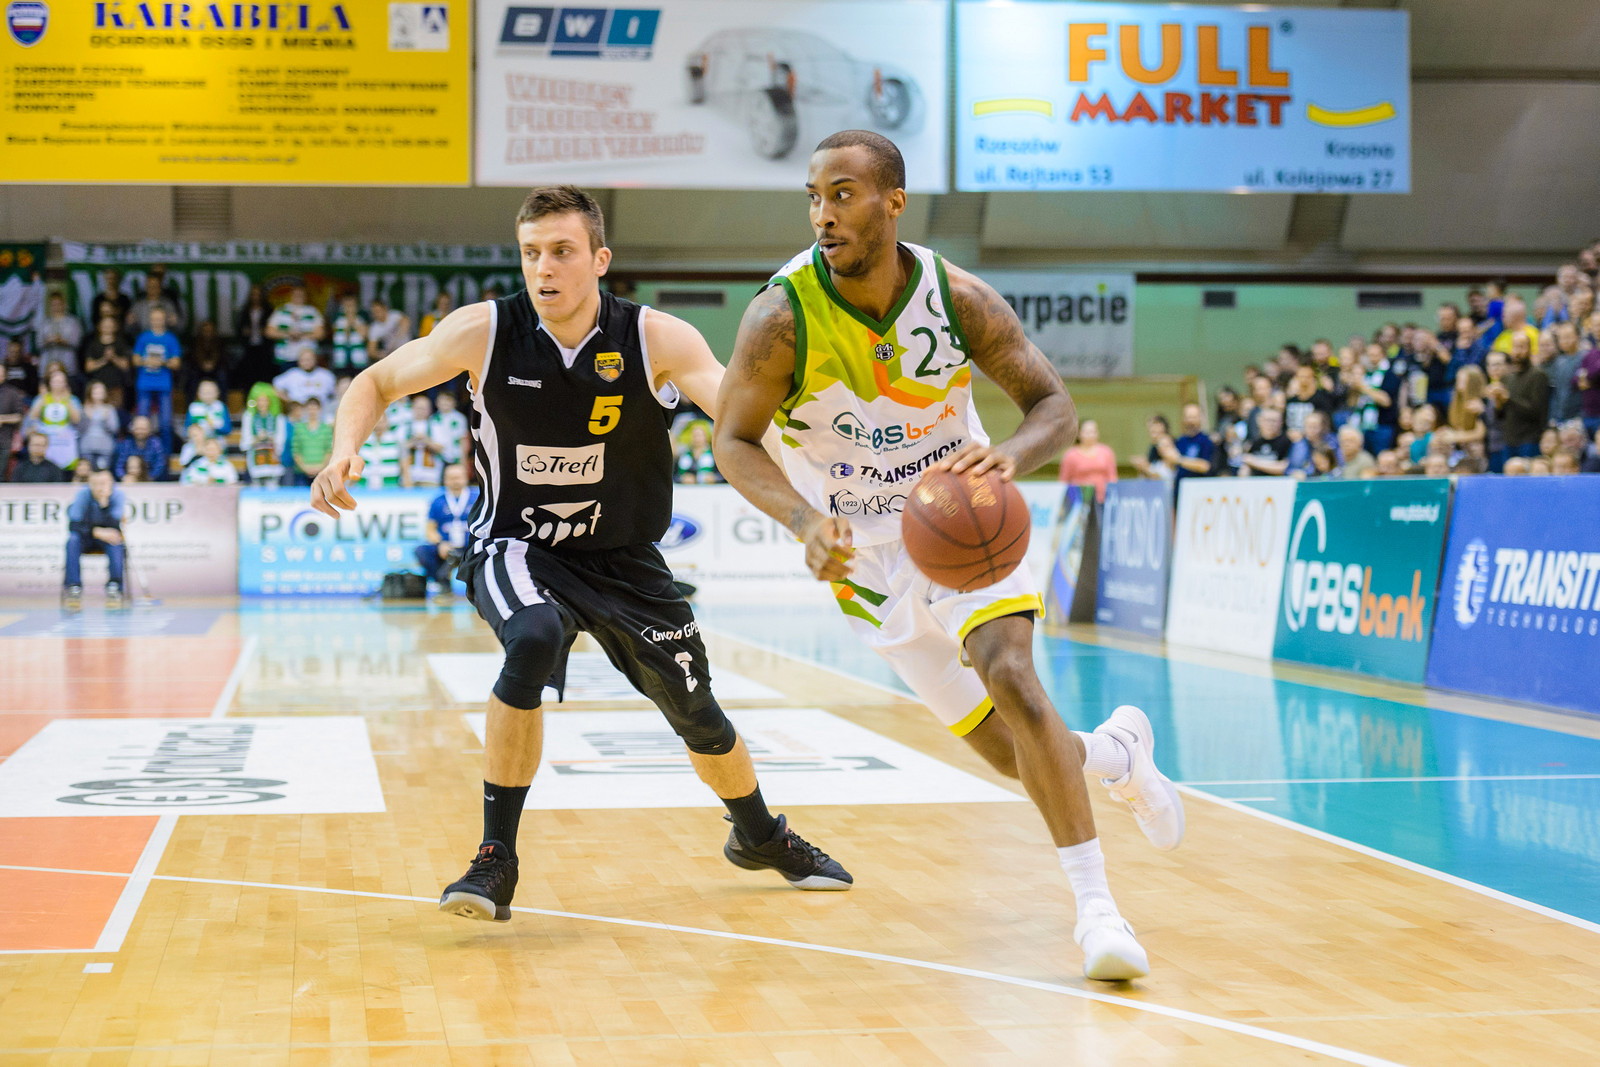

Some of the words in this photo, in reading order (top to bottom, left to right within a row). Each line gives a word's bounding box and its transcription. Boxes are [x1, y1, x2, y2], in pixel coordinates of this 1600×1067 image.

[93, 2, 355, 31] KARABELA
[512, 13, 641, 39] BWI
[1068, 23, 1290, 88] FULL
[1070, 91, 1291, 126] MARKET
[588, 395, 624, 435] 5
[549, 454, 598, 477] Trefl
[521, 502, 601, 547] Sopot
[1487, 607, 1600, 637] TECHNOLOG
